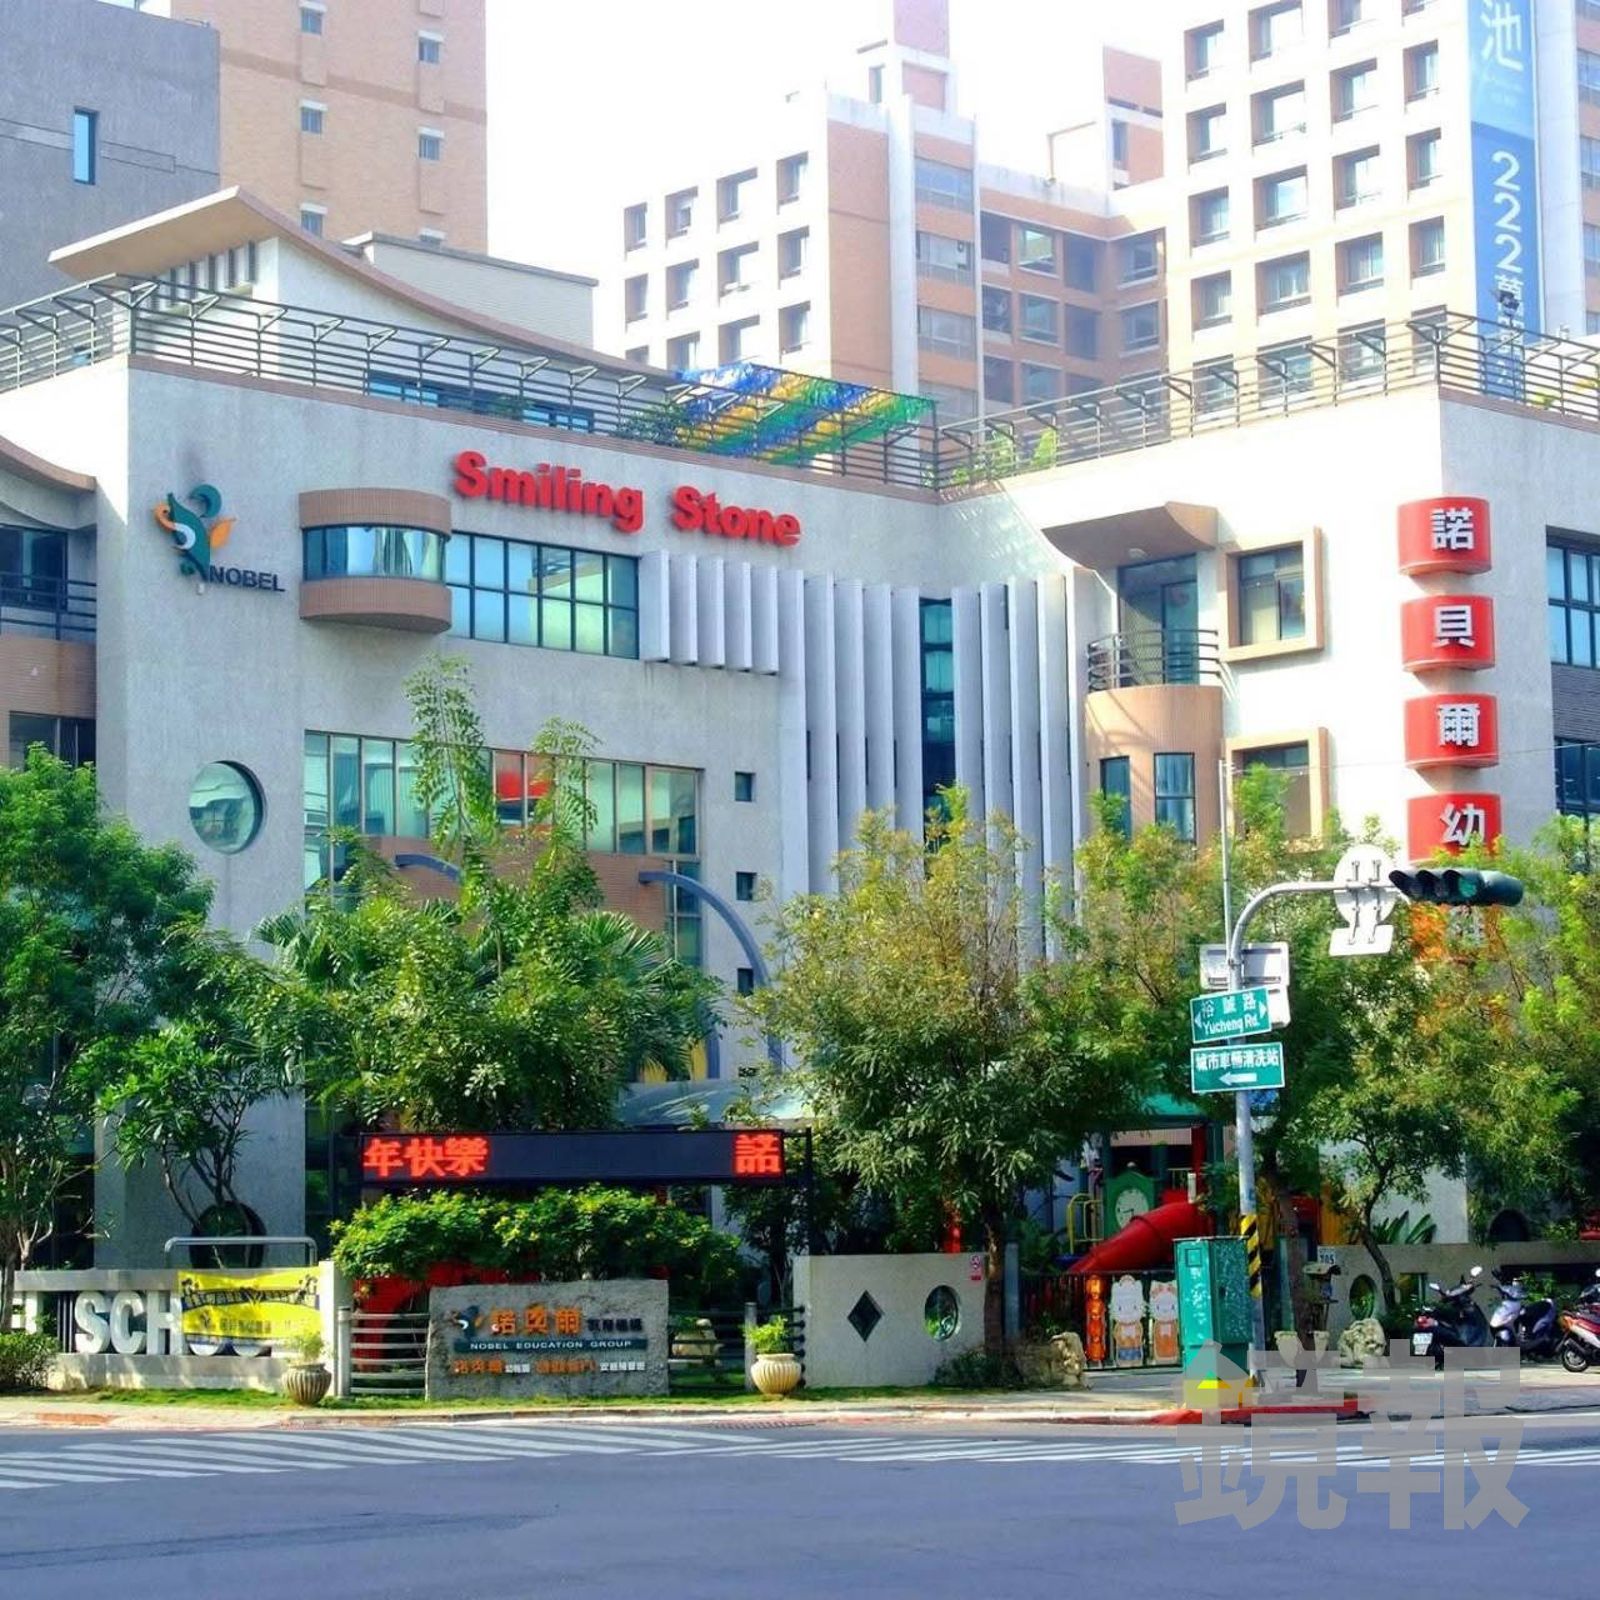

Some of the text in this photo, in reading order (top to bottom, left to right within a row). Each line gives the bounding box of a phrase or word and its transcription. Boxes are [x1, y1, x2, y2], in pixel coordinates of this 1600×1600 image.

[1480, 0, 1524, 72] 池
[454, 450, 802, 547] Smiling Stone
[209, 564, 286, 592] NOBEL
[1203, 1013, 1261, 1036] Yucheng Rd.
[363, 1136, 489, 1178] 年快樂
[470, 1340, 633, 1351] NOBEL EDUCATION GROUP
